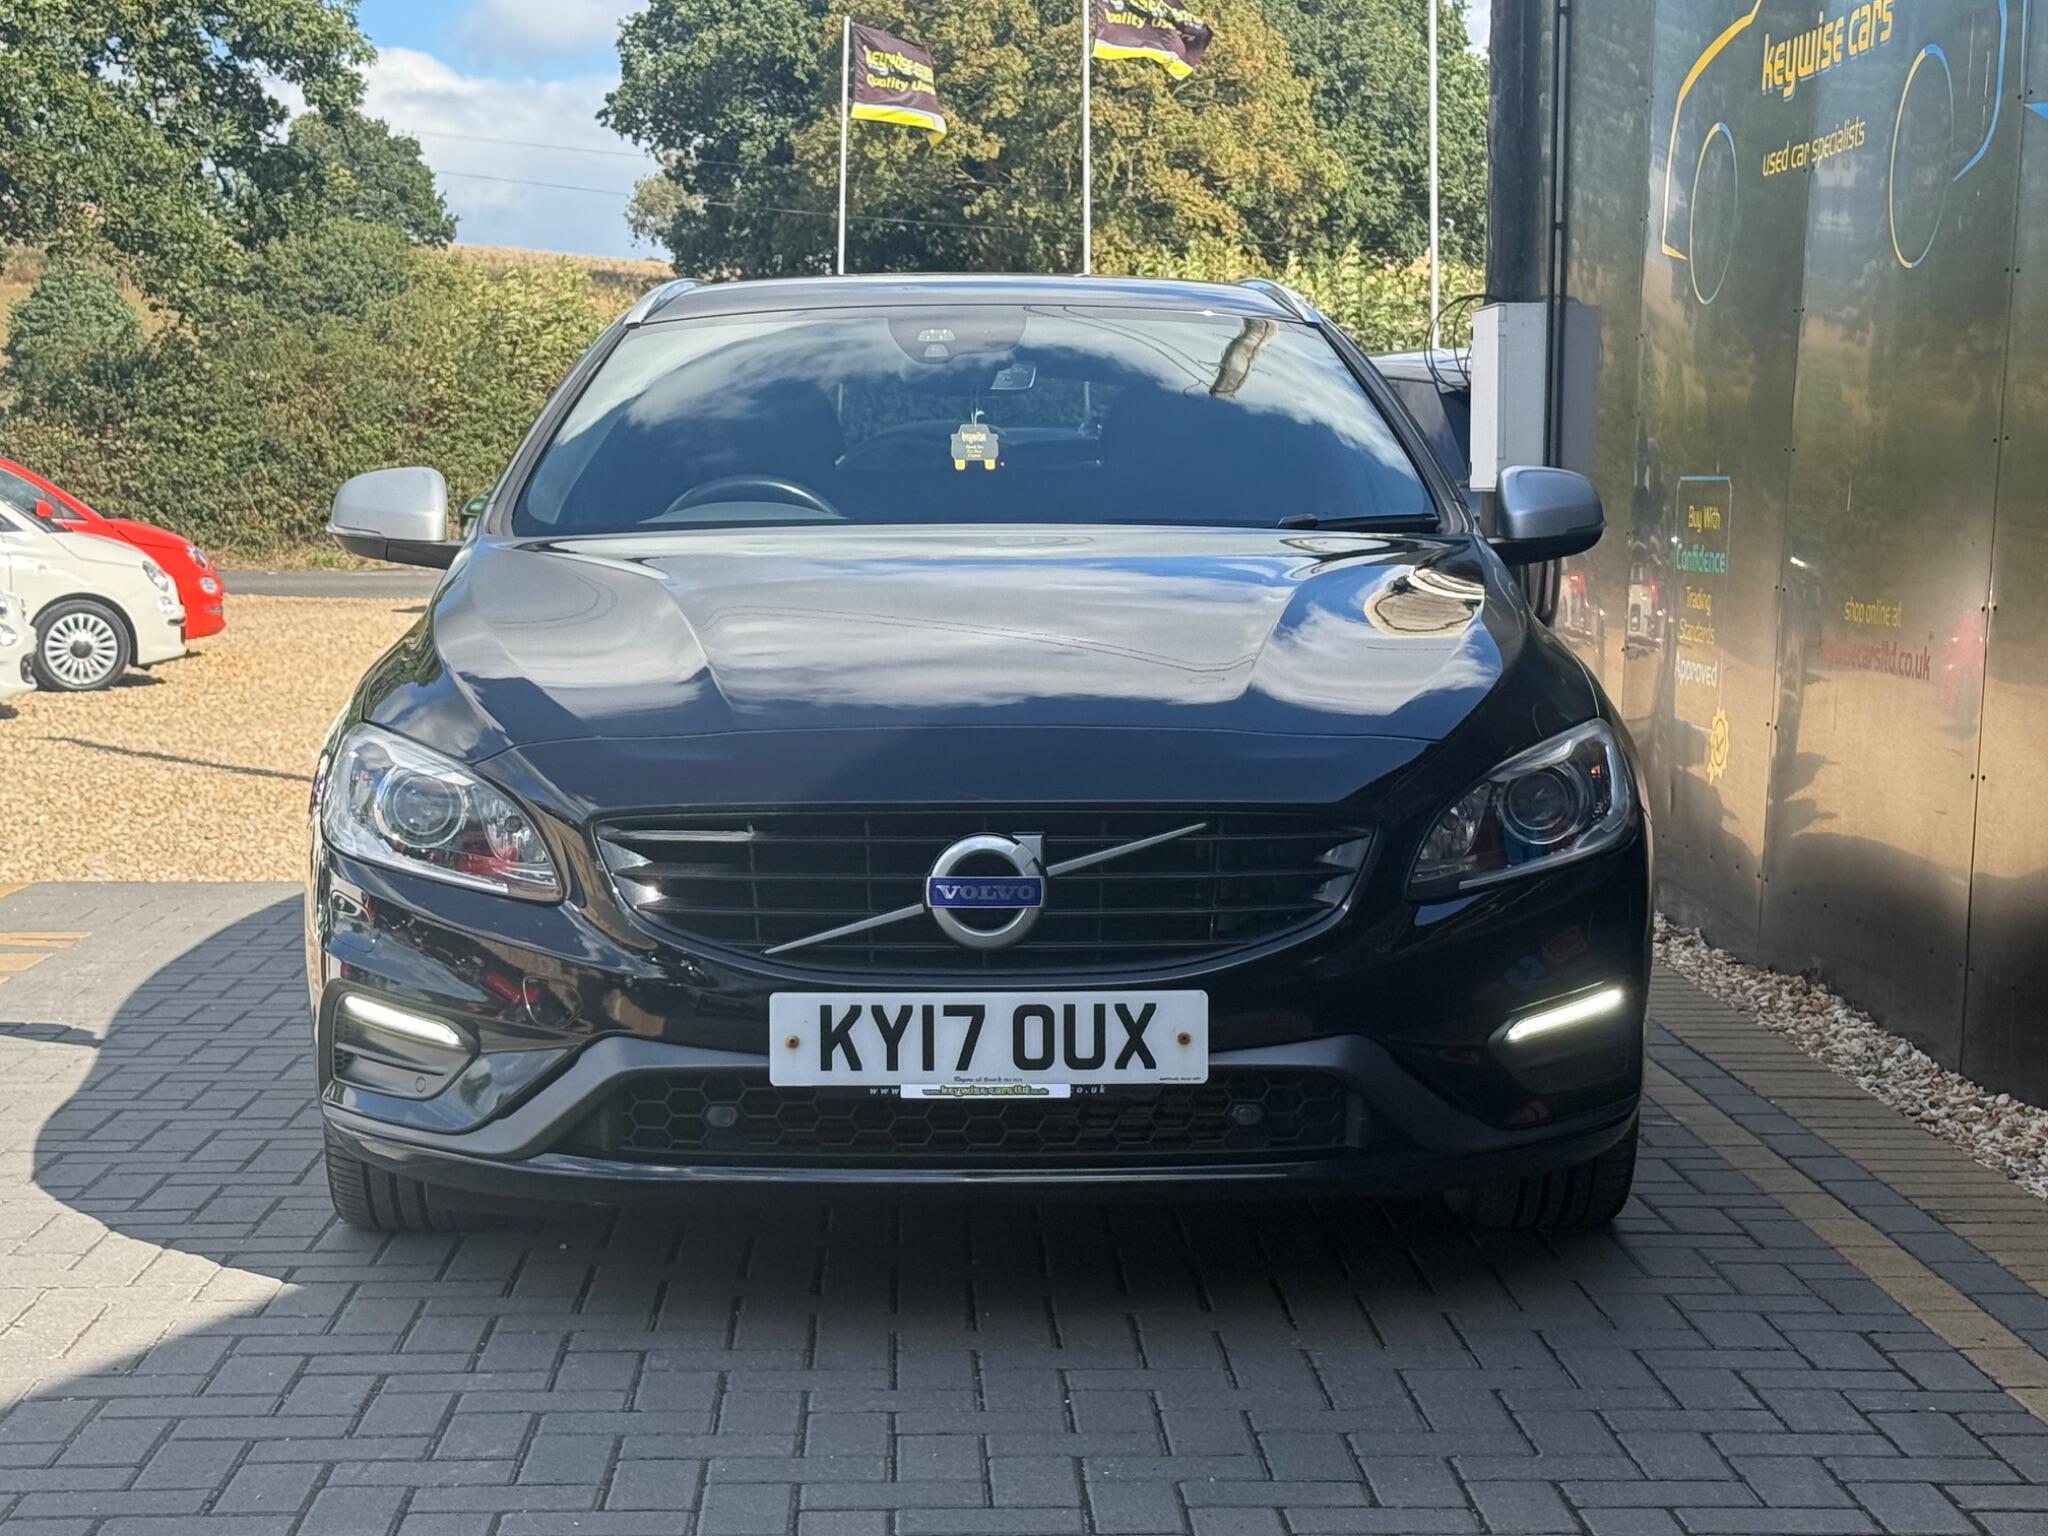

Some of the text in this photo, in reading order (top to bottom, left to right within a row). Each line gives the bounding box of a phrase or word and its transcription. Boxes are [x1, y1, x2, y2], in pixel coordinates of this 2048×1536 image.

[1761, 0, 1895, 102] keywise cars
[866, 73, 908, 93] Quality
[1762, 114, 1866, 177] used car specialists
[1687, 505, 1721, 533] Buy With
[1675, 542, 1727, 574] Confidence
[1686, 586, 1713, 616] Trading
[1844, 595, 1903, 628] shop online at
[1679, 616, 1715, 645] Standards
[1674, 653, 1719, 689] Approved
[936, 884, 1035, 900] VOLVO
[819, 1003, 1157, 1072] KY17 OUX
